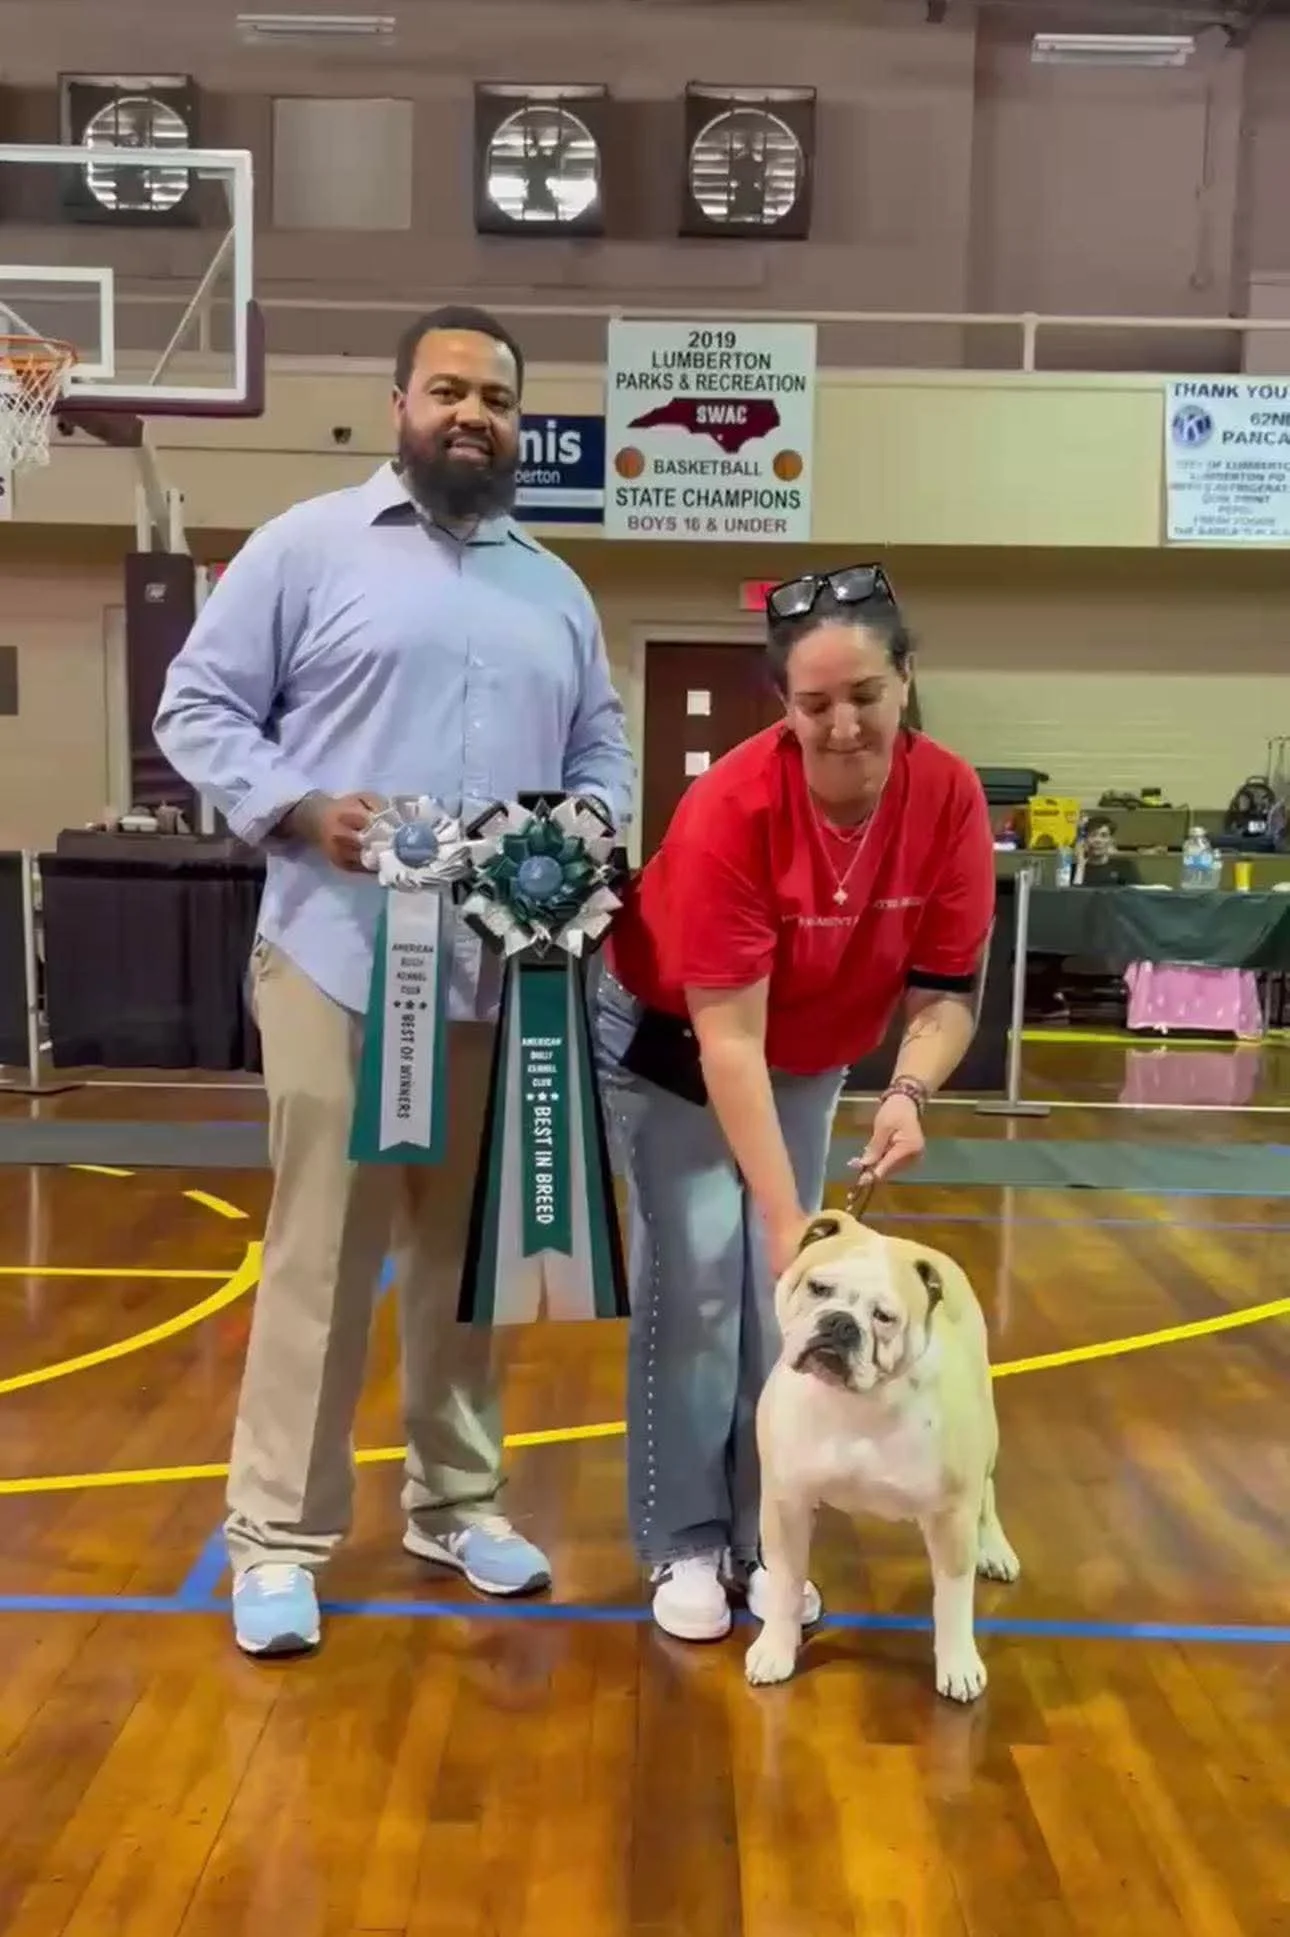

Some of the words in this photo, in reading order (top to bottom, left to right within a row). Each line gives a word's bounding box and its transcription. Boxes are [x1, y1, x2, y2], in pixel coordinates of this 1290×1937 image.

[688, 331, 736, 348] 2019
[651, 351, 771, 369] LUMBERTON
[616, 372, 673, 390] PARKS
[679, 374, 690, 390] &
[696, 373, 806, 392] RECREATION
[1174, 383, 1239, 398] THANK
[1247, 384, 1288, 399] YOU
[696, 405, 747, 424] SWAC
[653, 459, 762, 476] BASKETBALL
[616, 487, 676, 507] STATE
[682, 489, 801, 509] CHAMPIONS
[627, 515, 677, 531] BOYS
[684, 517, 700, 531] 16
[706, 518, 718, 532] &
[725, 518, 787, 533] UNDER
[401, 1013, 415, 1043] BEST
[400, 1046, 414, 1061] OF
[396, 1065, 412, 1119] WINNERS
[534, 1106, 552, 1145] BEST
[535, 1151, 552, 1168] IN
[535, 1173, 554, 1224] BREED
